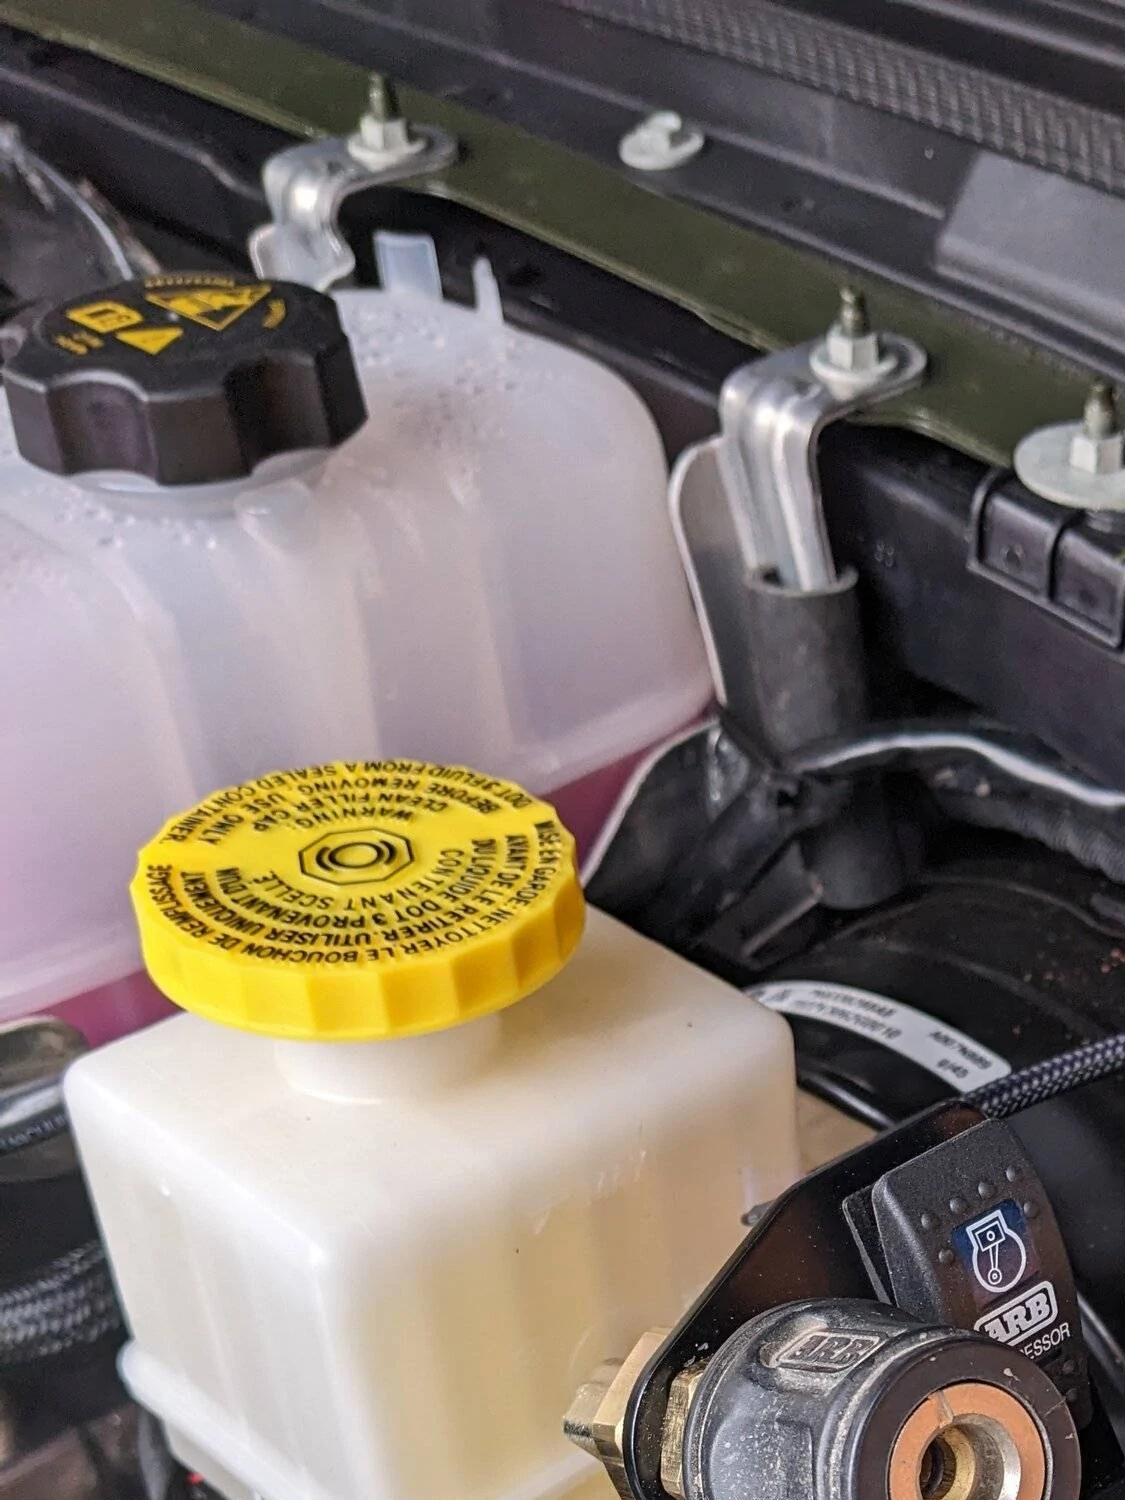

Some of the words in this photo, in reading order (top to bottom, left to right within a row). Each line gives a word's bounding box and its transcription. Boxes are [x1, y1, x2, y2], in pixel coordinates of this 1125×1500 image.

[256, 765, 337, 790] SEALED
[344, 763, 357, 773] A
[363, 761, 427, 773] FROM
[428, 766, 485, 788] FLUID
[243, 793, 287, 814] USE
[294, 792, 371, 813] FILLER
[379, 792, 449, 813] CLEAN
[425, 782, 502, 814] BEFORE
[504, 787, 533, 810] DOT
[199, 814, 245, 845] ONLY
[252, 808, 290, 832] CAP
[534, 819, 561, 847] MISE
[471, 838, 497, 856] DU
[504, 834, 530, 871] AVANT
[539, 850, 562, 864] EN
[343, 848, 465, 911] CONTENANT
[437, 855, 497, 903] LIQUIDE
[491, 871, 521, 890] DE
[146, 864, 216, 940] REMPLISSAGE
[471, 887, 504, 907] LE
[230, 894, 366, 931] PROVENANT
[371, 912, 388, 927] 3
[394, 899, 443, 924] DOT
[208, 931, 243, 951] DE
[264, 927, 371, 948] UTILISER
[401, 908, 514, 956] NETTOYER
[241, 942, 359, 965] BOUCHON
[367, 946, 395, 962] LE
[984, 1291, 1051, 1344] ARB
[784, 1333, 878, 1365] ARB
[1020, 1321, 1071, 1360] ESSOR
